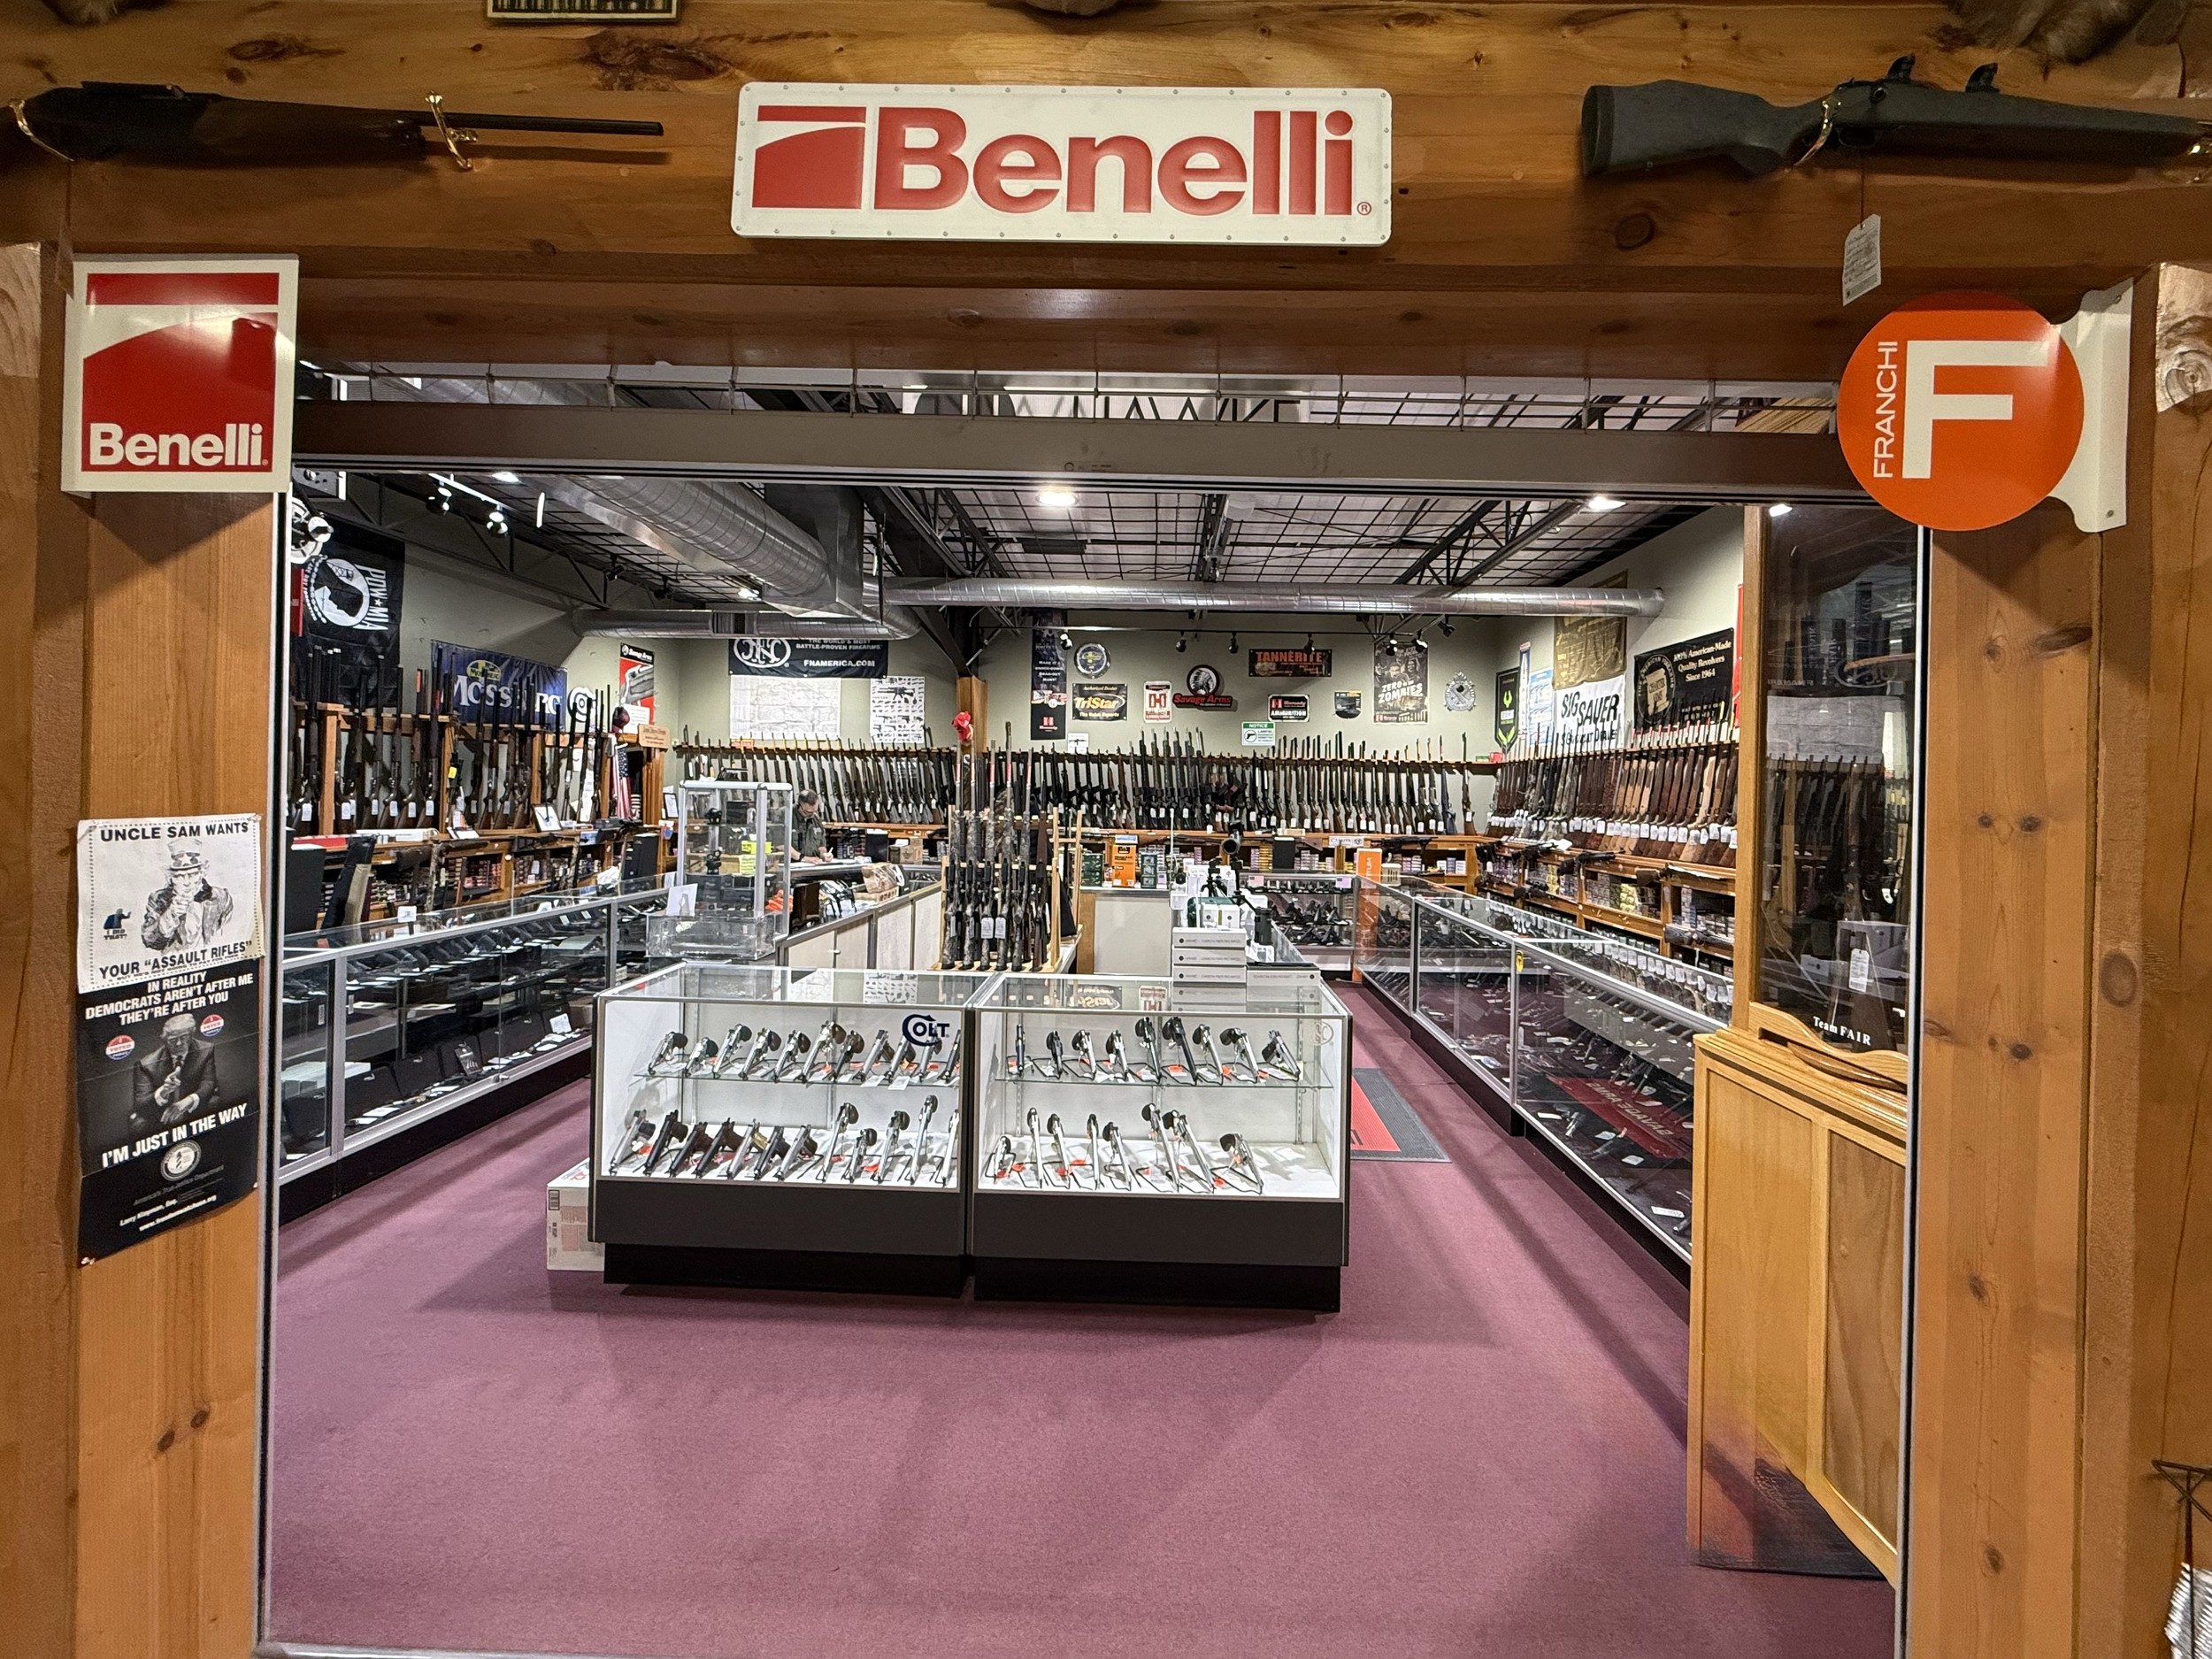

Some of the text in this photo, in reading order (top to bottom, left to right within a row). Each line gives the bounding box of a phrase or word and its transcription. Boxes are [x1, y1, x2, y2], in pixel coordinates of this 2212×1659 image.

[873, 105, 1354, 218] Benelli
[1873, 341, 1898, 478] FRANCHI
[1902, 340, 2050, 479] F
[89, 422, 263, 466] Benelli
[1256, 650, 1323, 663] TANNERITE
[1688, 640, 1732, 658] American-Made
[1678, 655, 1725, 672] Quality Revolvers
[1686, 668, 1716, 682] Since 1964
[1378, 682, 1423, 704] ZOMBIES
[1381, 680, 1402, 693] ZERO
[1074, 695, 1119, 709] TriStar
[1173, 694, 1206, 706] Savage
[1207, 695, 1232, 703] Arms
[1561, 690, 1581, 718] SIG
[1578, 693, 1620, 727] SAUER
[100, 822, 249, 842] UNCLE SAM WANTS
[99, 961, 140, 979] YOUR
[147, 971, 208, 994] IN REALITY
[85, 973, 254, 1020] DEMOCRATS AREN'T AFTER ME
[119, 990, 230, 1026] THEY'RE AFTER YOU
[902, 1013, 950, 1047] COLT
[1813, 1016, 1871, 1046] Team FAIR
[102, 1102, 248, 1168] I'M JUST IN THE WAY
